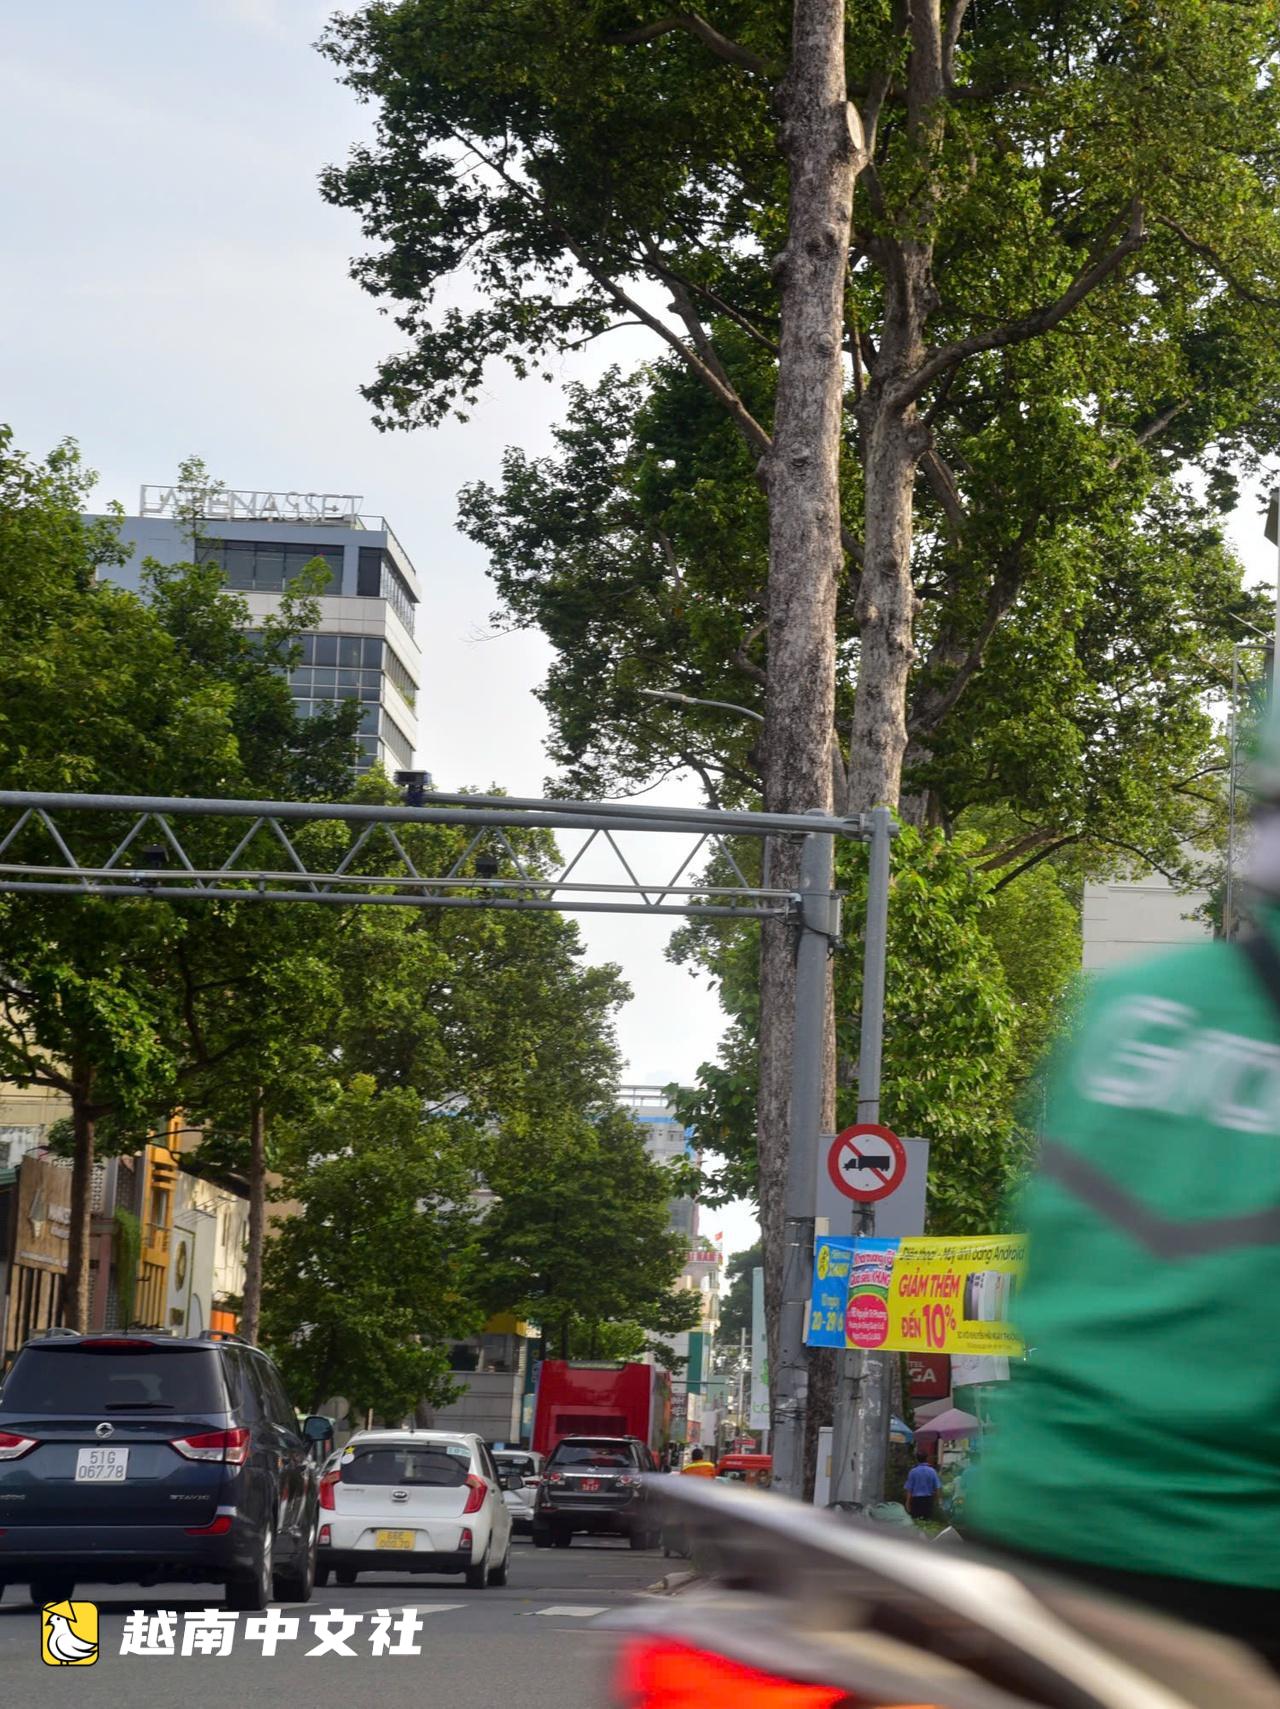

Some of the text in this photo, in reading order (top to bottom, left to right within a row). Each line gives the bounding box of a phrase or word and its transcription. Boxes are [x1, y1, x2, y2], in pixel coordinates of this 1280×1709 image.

[899, 1267, 929, 1298] GIẢM
[901, 1303, 956, 1349] ĐẾN 10%
[89, 1451, 116, 1464] 51G
[78, 1465, 124, 1480] 067.78
